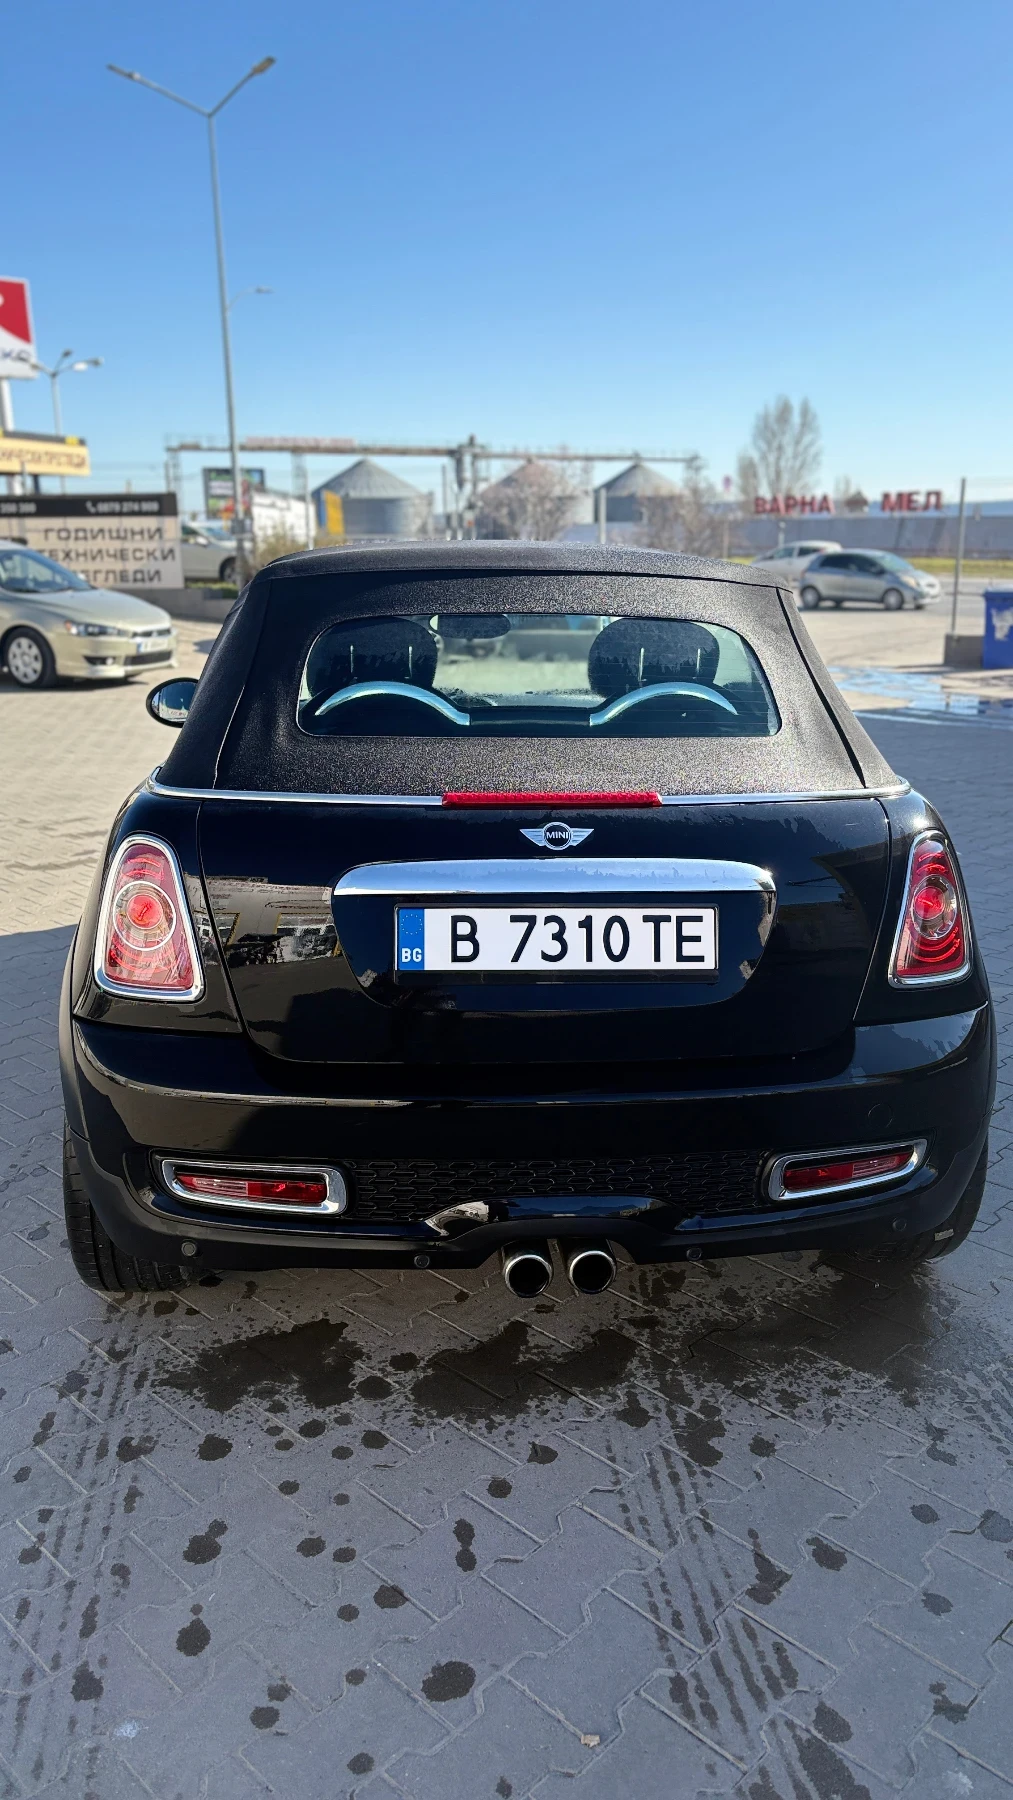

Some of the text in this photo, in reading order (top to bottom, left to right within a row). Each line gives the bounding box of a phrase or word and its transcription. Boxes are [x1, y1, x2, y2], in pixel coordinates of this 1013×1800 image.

[754, 491, 942, 515] ВАРНА МЕЛ
[44, 527, 163, 541] ГОДИШНИ
[546, 831, 569, 839] MINI
[450, 915, 705, 963] B 7310 TE
[401, 947, 422, 963] BG
